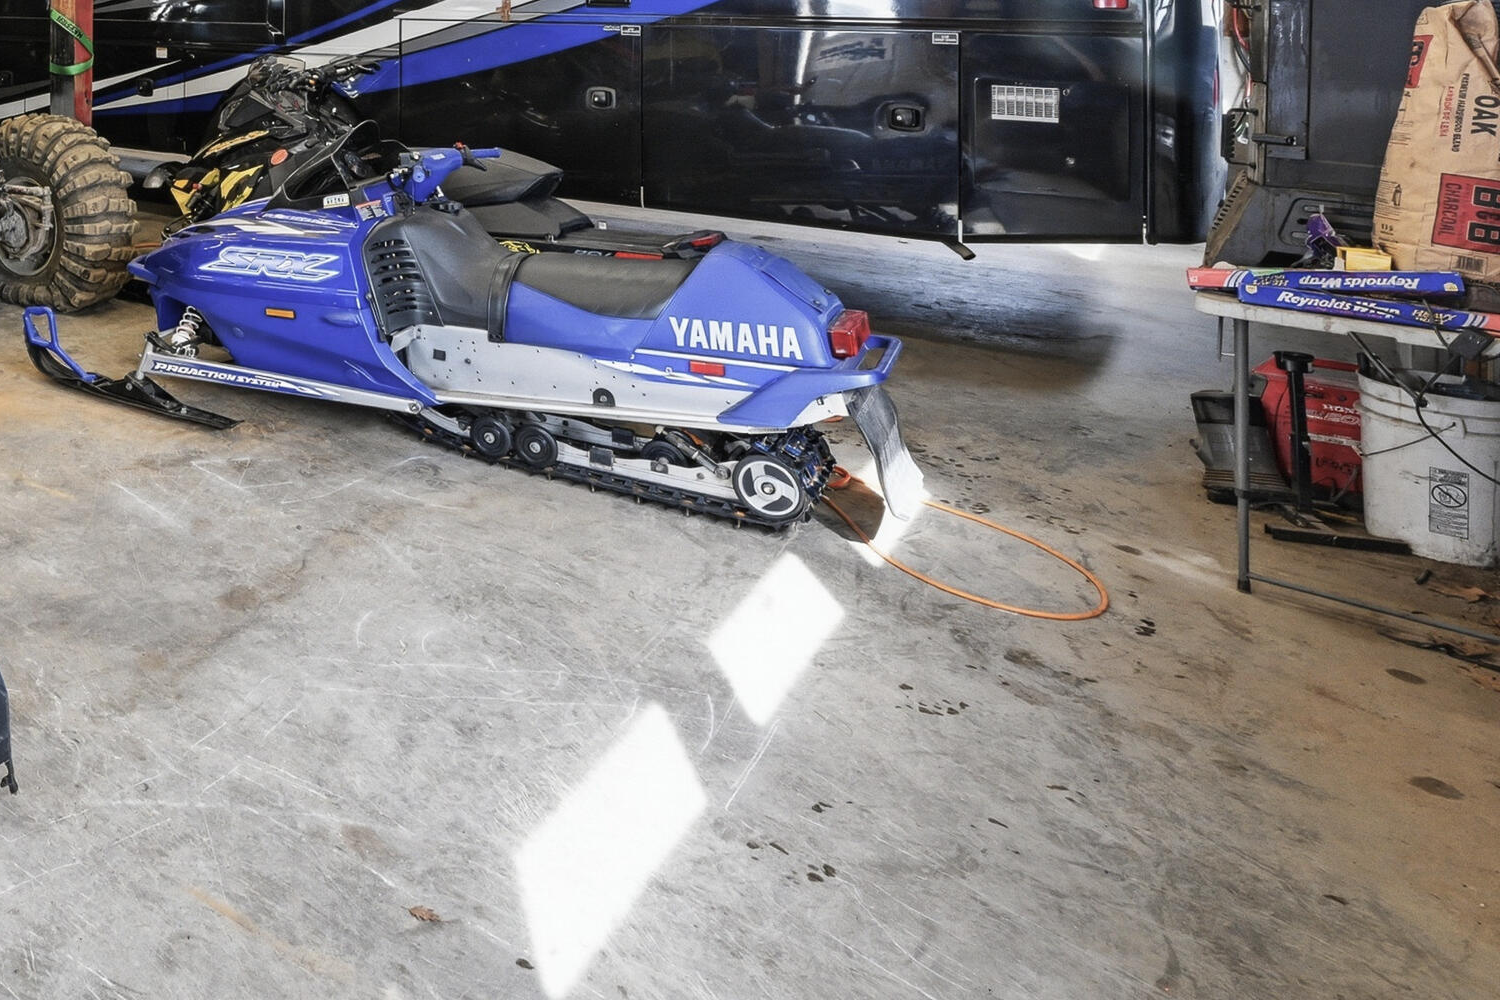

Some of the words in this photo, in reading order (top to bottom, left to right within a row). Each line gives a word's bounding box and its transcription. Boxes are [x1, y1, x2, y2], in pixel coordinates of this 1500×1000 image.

[1470, 94, 1500, 137] OAK
[1439, 181, 1462, 236] CHARCOAL
[199, 246, 341, 281] SRX
[1299, 275, 1342, 289] Wrap
[1343, 277, 1421, 292] Reynolds
[1276, 290, 1352, 311] Reynolds
[668, 316, 804, 361] YAMAHA
[154, 361, 236, 381] PROACTION
